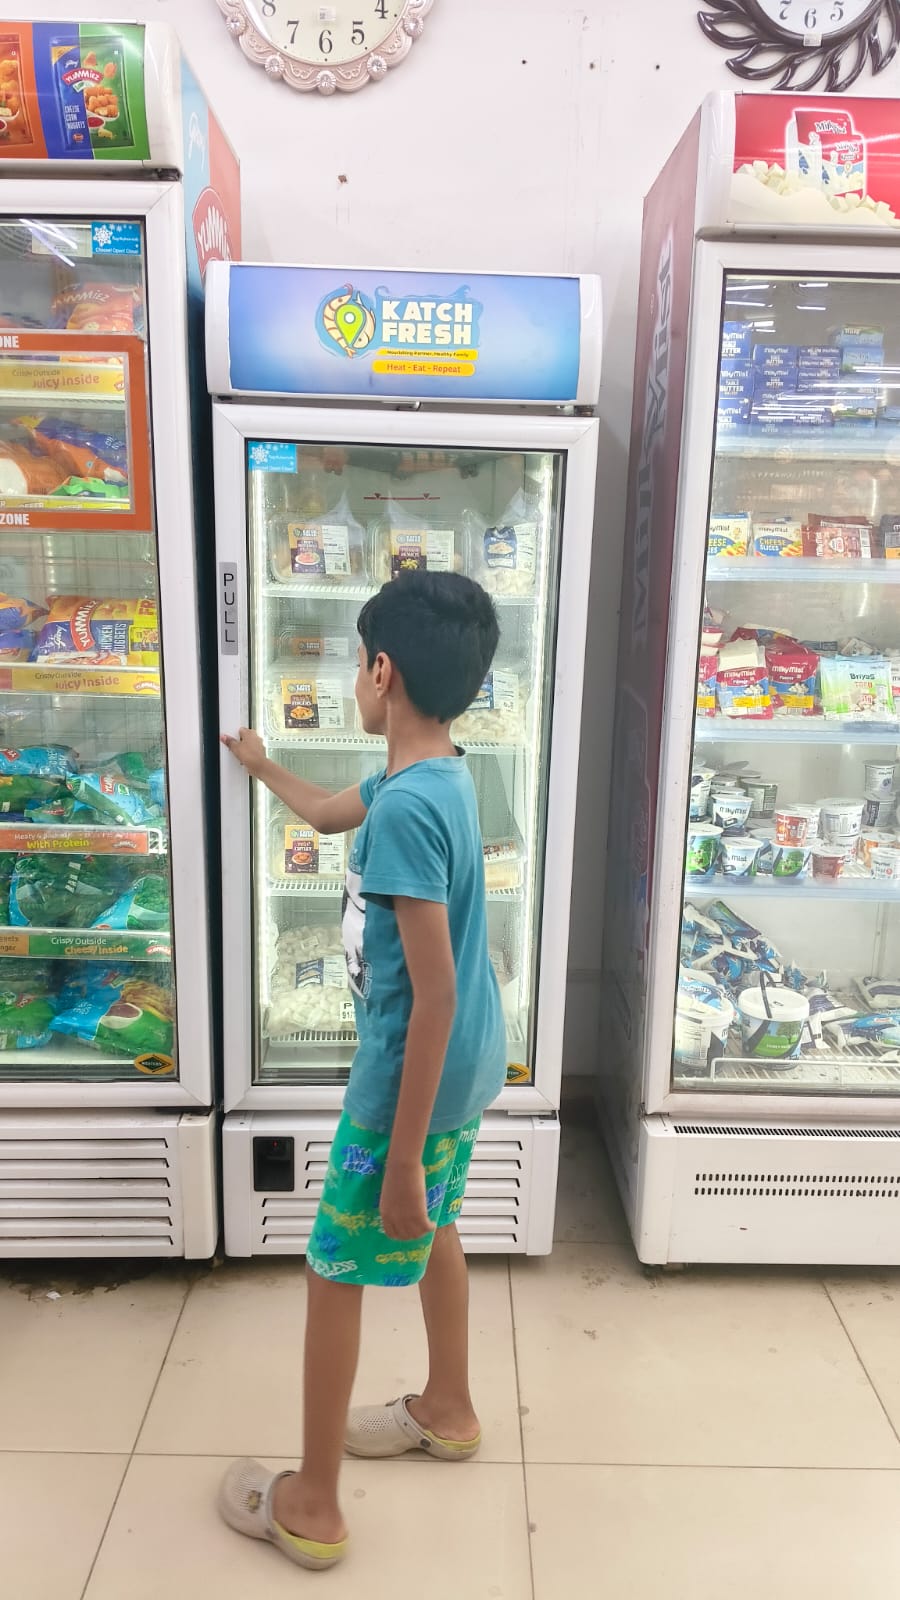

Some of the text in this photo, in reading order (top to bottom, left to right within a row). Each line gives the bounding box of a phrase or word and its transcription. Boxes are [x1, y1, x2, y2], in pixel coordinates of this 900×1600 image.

[262, 0, 276, 17] 8
[374, 0, 389, 19] 4
[779, 0, 792, 20] 7
[830, 1, 844, 21] 5
[804, 8, 817, 29] 6
[286, 20, 300, 44] 7
[318, 29, 333, 54] 6
[351, 21, 365, 46] 5
[382, 300, 473, 323] KATCH
[382, 322, 472, 345] FRESH
[387, 363, 461, 374] Heat Eat Repeat
[62, 374, 100, 386] Inside
[0, 513, 29, 526] ZONE
[759, 538, 786, 546] CHEESE
[223, 573, 236, 643] PULL
[101, 624, 113, 651] HICKEN
[83, 675, 120, 687] Inside
[26, 839, 90, 849] With Protein
[51, 937, 107, 946] Crispy Outside
[98, 945, 129, 954] Inside
